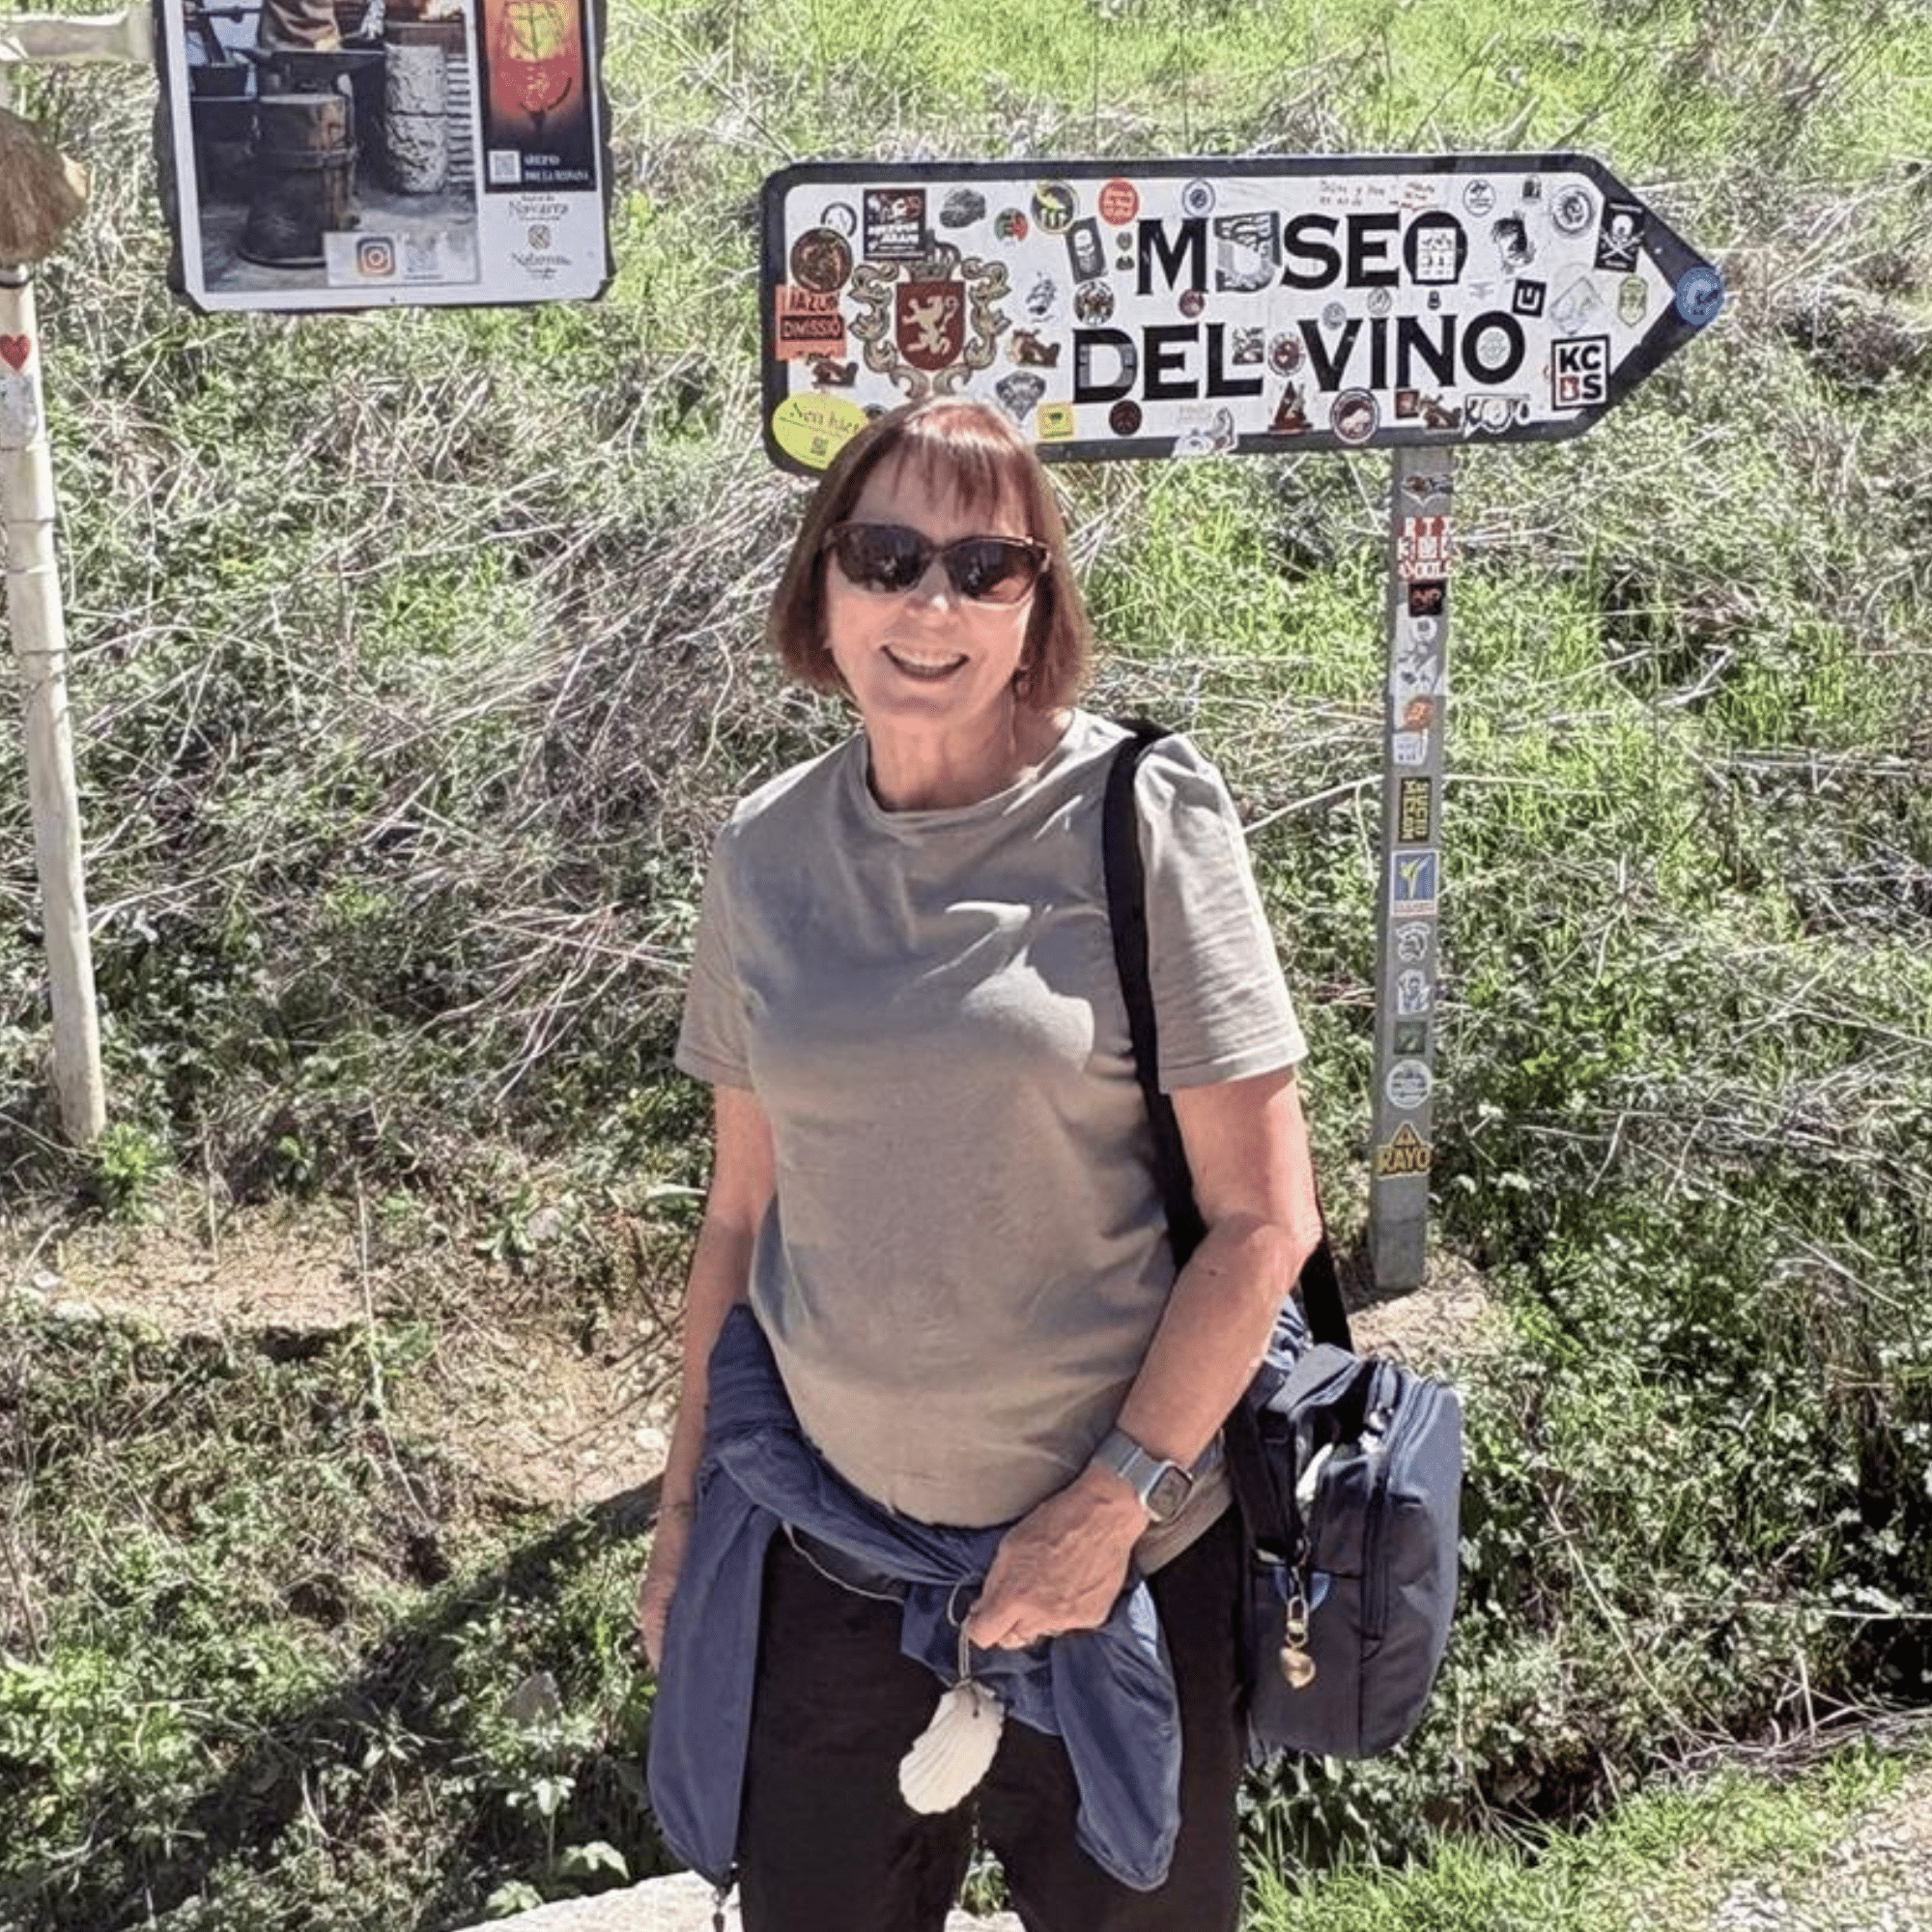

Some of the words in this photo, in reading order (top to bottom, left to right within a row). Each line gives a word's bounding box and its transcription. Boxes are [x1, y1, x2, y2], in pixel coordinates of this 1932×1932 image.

[1136, 210, 1467, 296] MUSEO
[1073, 323, 1264, 404] DEL
[1297, 310, 1525, 392] VINO
[1560, 344, 1601, 373] KC
